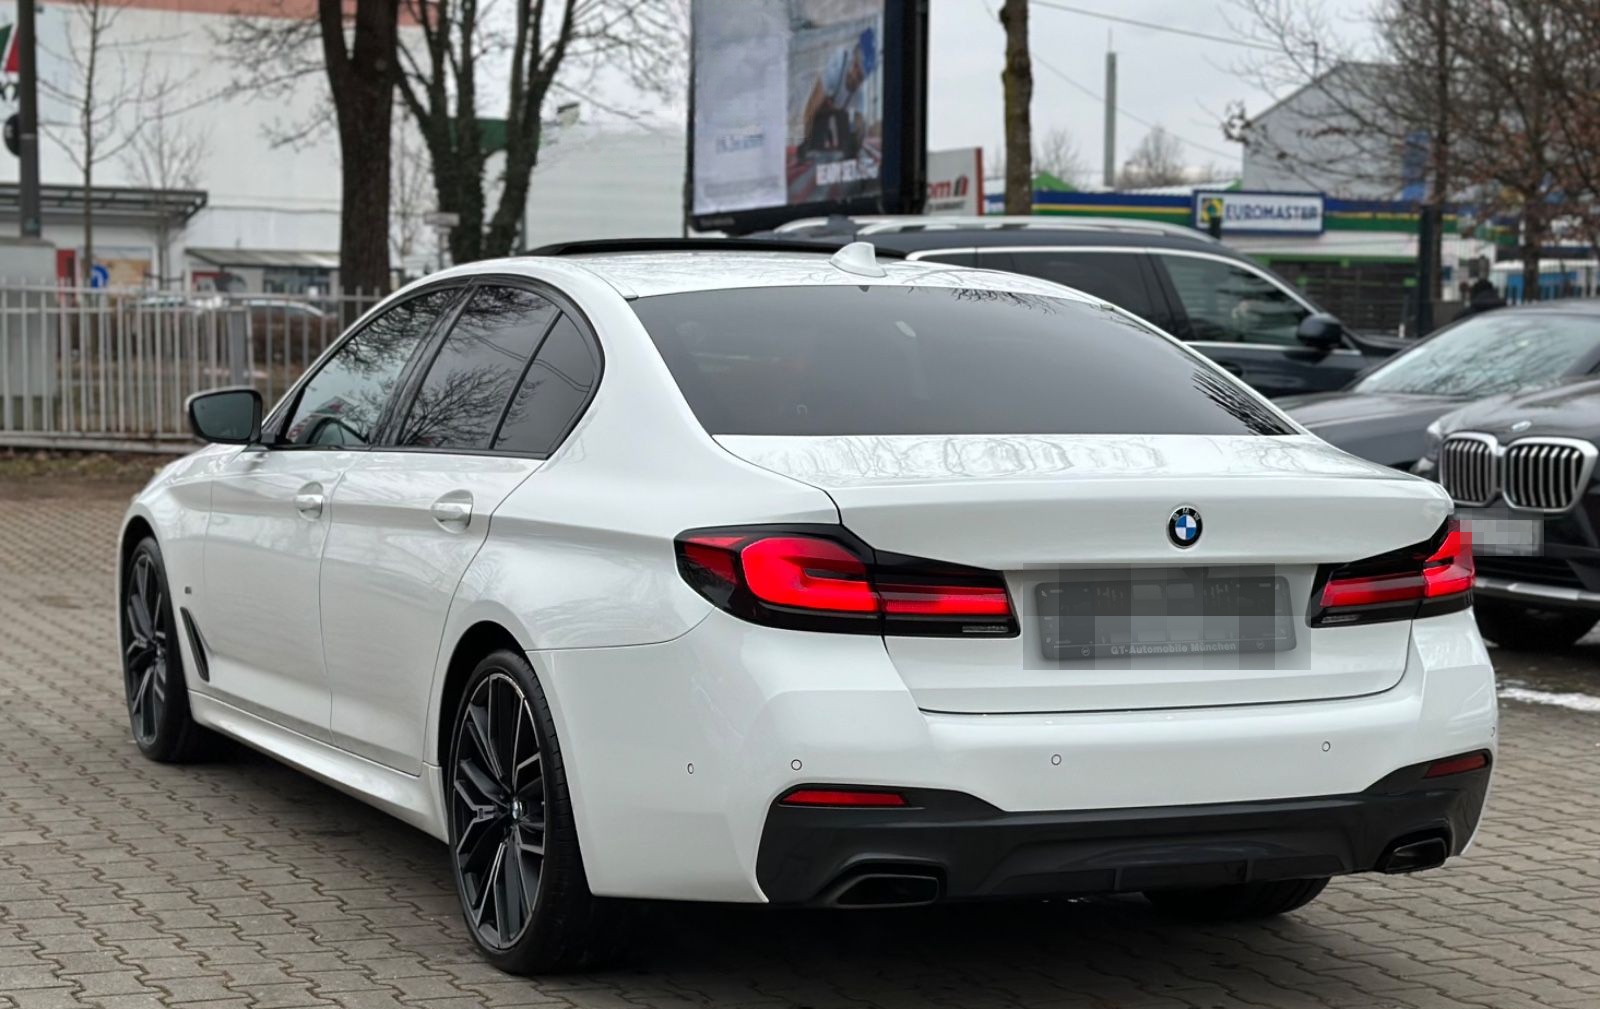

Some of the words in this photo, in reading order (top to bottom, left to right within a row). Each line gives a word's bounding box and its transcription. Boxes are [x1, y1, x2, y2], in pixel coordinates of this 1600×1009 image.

[1226, 203, 1318, 220] EUROMASTER
[1110, 643, 1188, 655] GT-Automobile
[1190, 641, 1237, 653] München
